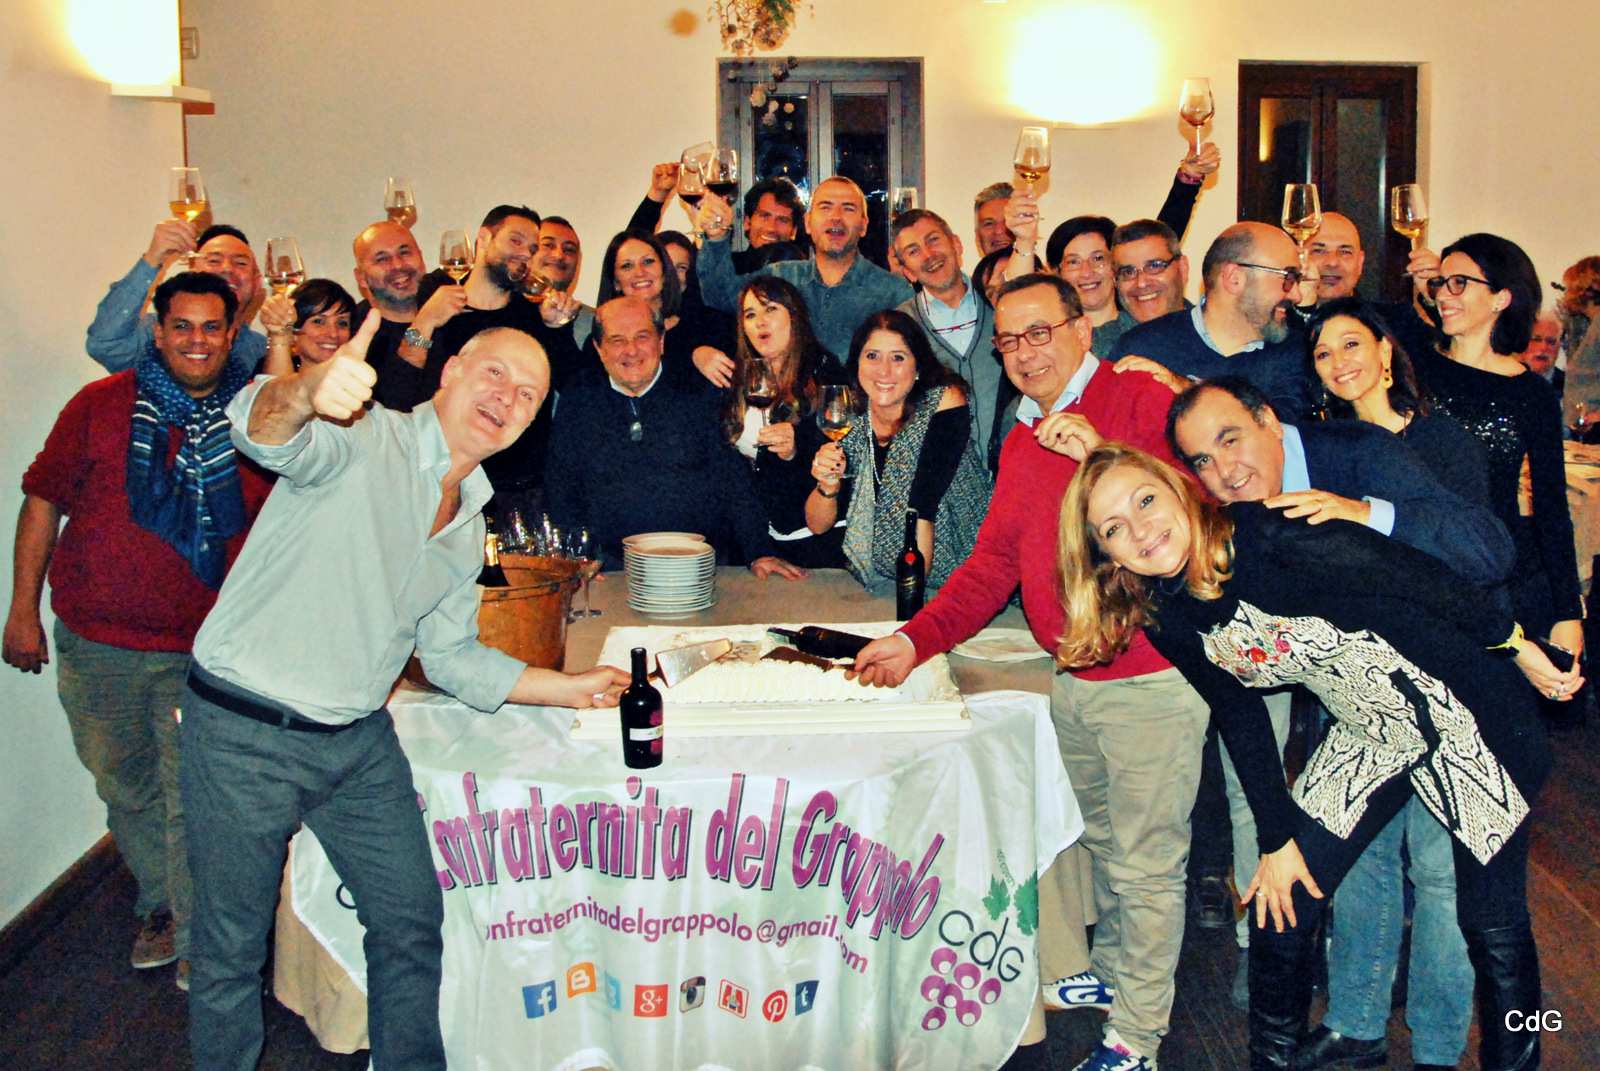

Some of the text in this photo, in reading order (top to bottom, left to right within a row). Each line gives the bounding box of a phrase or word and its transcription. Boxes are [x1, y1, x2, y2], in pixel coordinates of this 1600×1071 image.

[417, 771, 944, 940] onfraternita del Grappolo
[939, 909, 1024, 982] CdG
